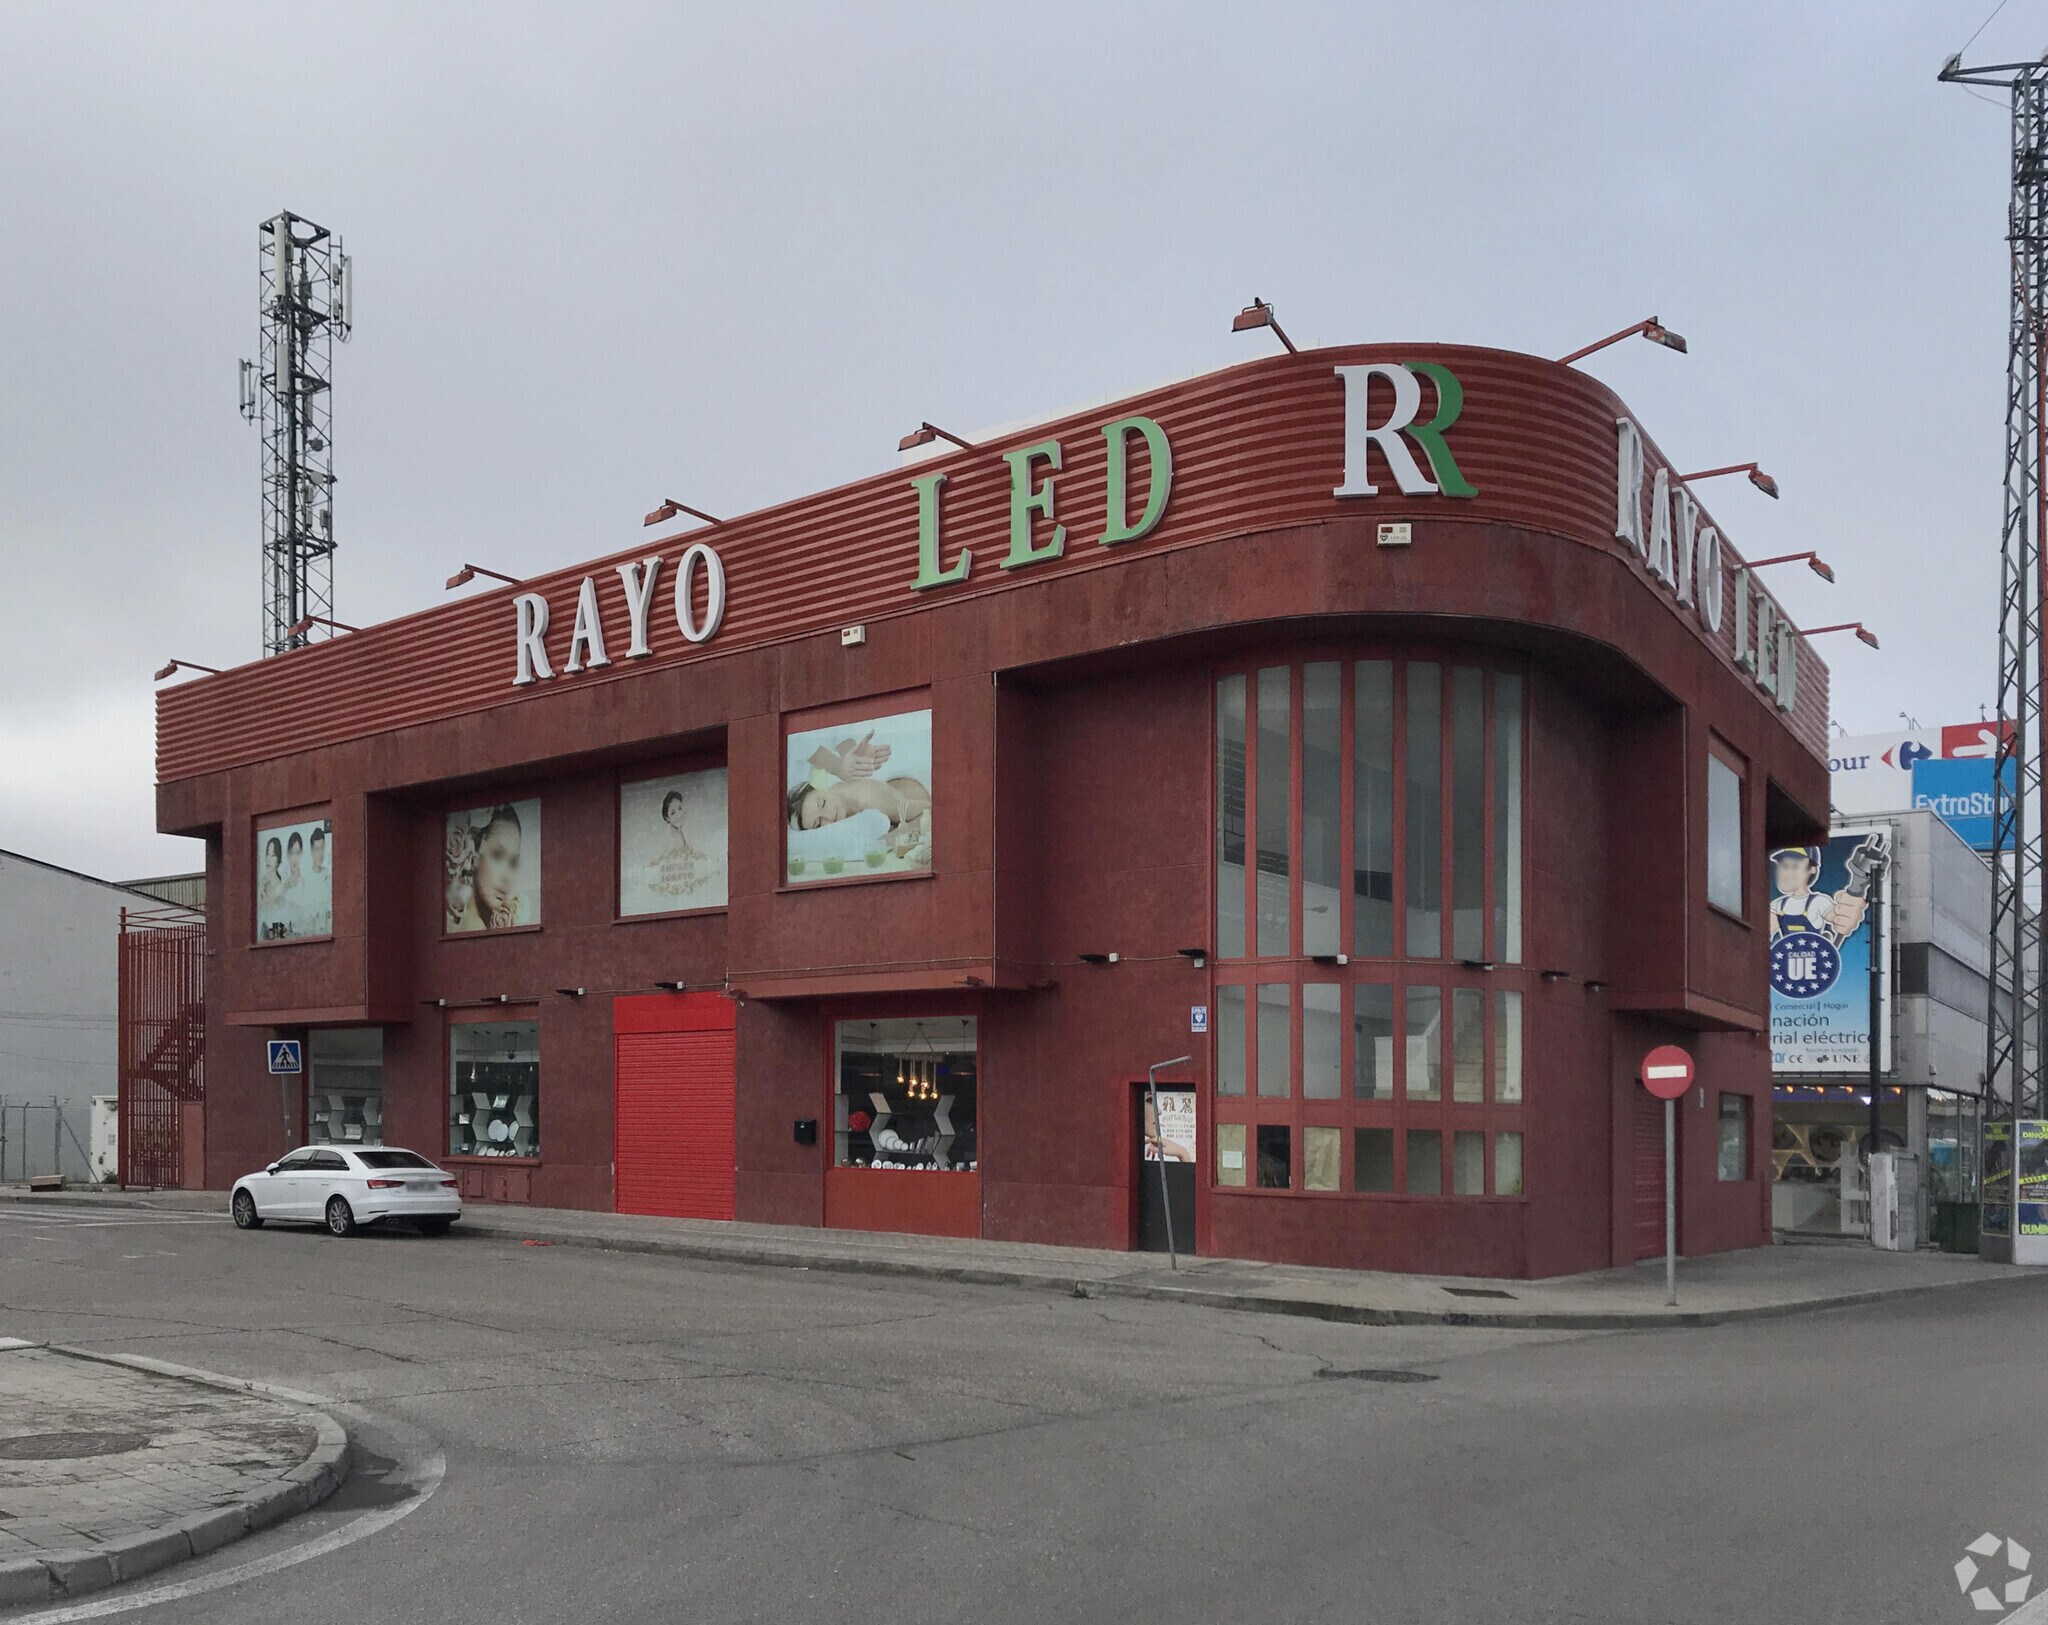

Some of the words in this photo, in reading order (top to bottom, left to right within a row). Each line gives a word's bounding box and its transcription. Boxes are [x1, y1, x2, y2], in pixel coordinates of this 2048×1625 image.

[512, 543, 726, 686] RAYO
[910, 415, 1174, 591] LED
[1615, 417, 1723, 634] RAYO
[1733, 564, 1797, 713] LED
[1788, 957, 1817, 980] UE
[1823, 1003, 1848, 1011] Hogar
